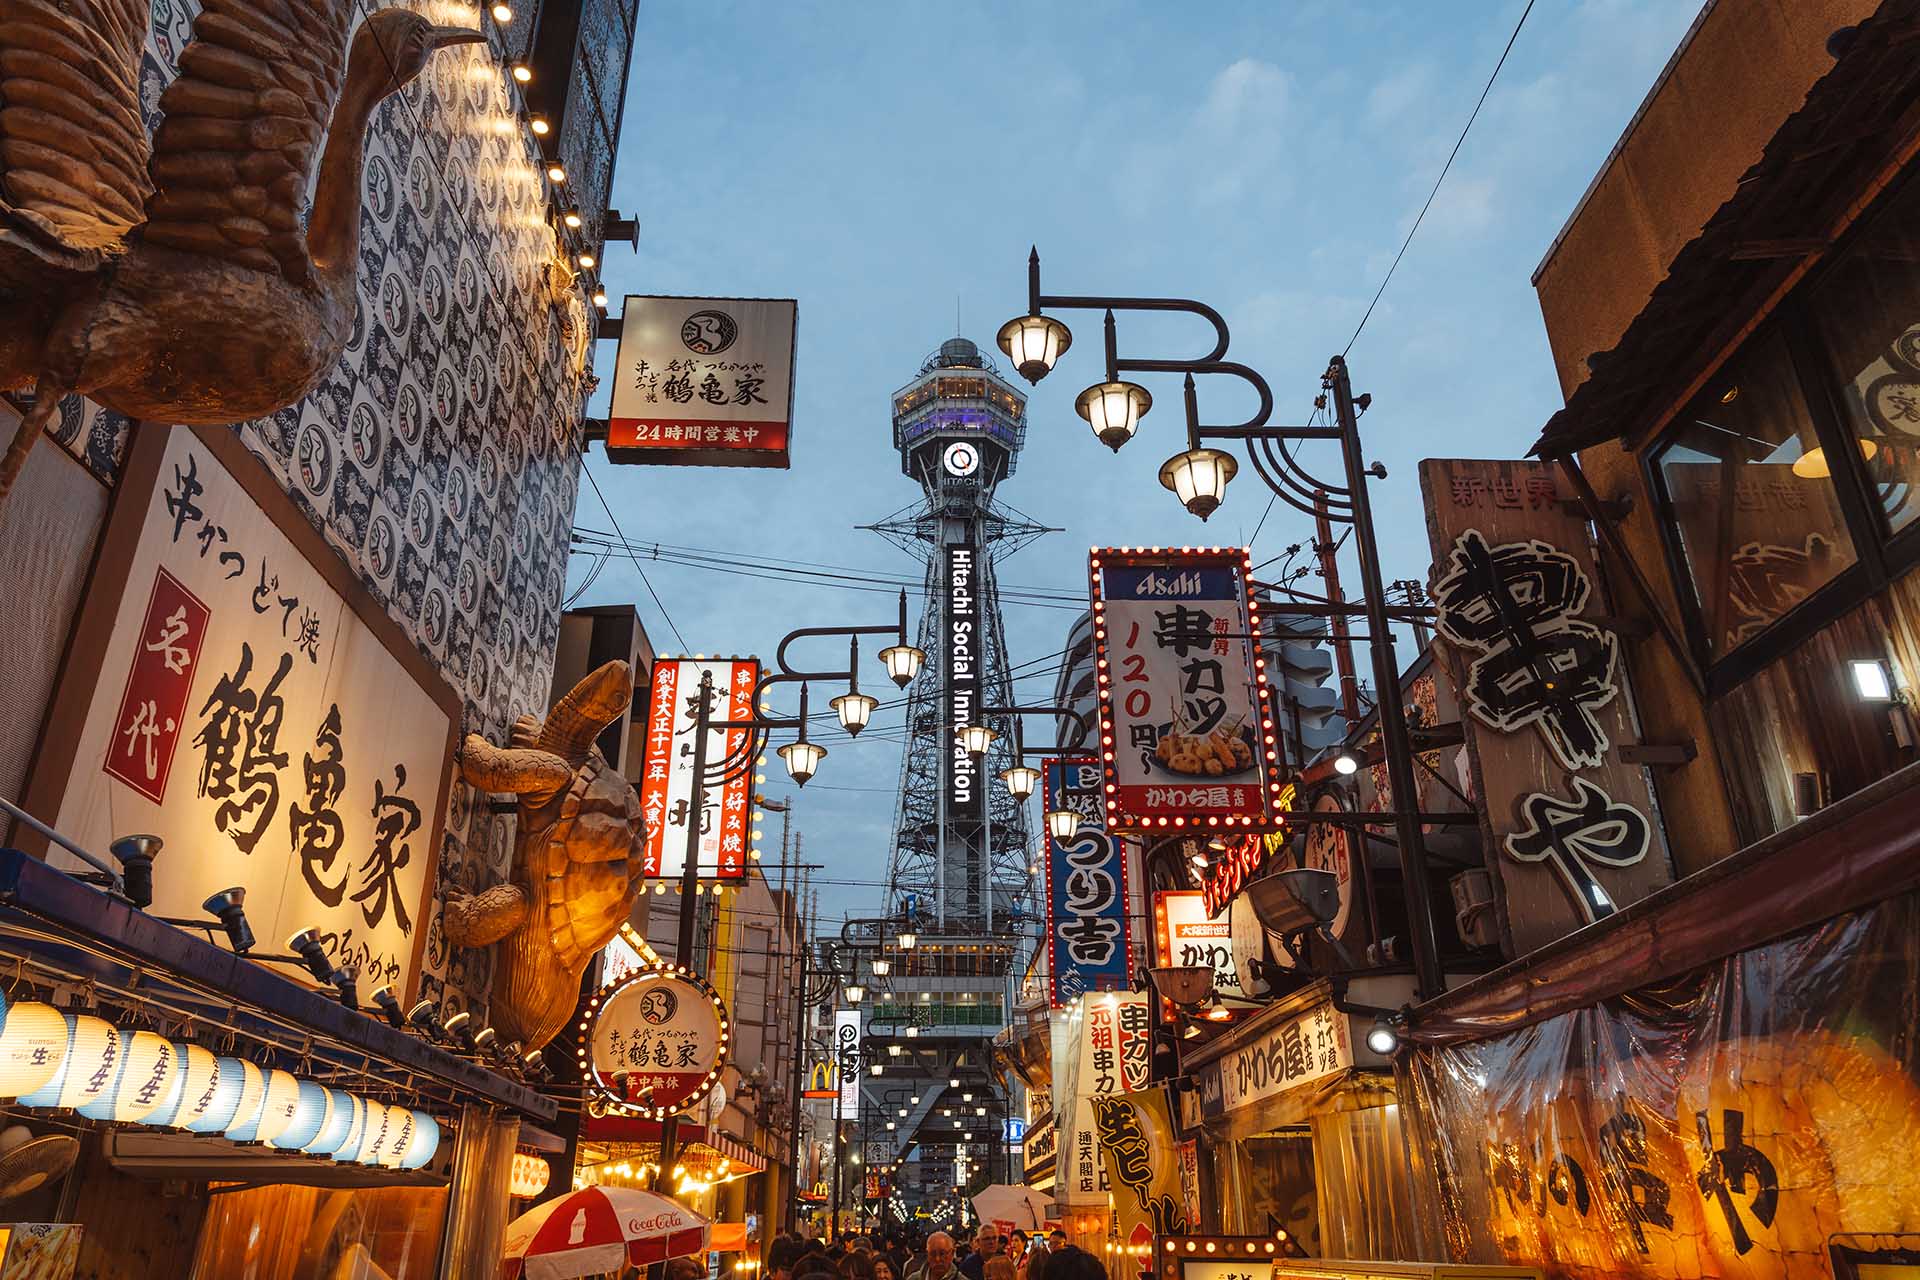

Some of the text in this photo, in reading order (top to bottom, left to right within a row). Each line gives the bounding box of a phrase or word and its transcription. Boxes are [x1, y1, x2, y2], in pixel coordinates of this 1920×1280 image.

[662, 371, 769, 406] 鶴亀家
[635, 424, 760, 443] 24時間営業中
[952, 550, 973, 614] Hitachi
[1136, 572, 1202, 596] Asahi
[952, 622, 974, 680] Social
[1153, 604, 1228, 735] 串カツ
[123, 605, 192, 780] 名代
[648, 668, 676, 782] 創業大正十二年
[193, 642, 424, 938] 鶴亀家
[1145, 787, 1231, 808] かわち屋
[1055, 827, 1120, 965] つり吉
[627, 1075, 679, 1089] 年中無休
[628, 1039, 699, 1067] 鶴亀家
[1236, 1020, 1306, 1097] かわち屋
[1078, 1131, 1094, 1193] 通天閣店
[1099, 1100, 1187, 1236] 生ビール
